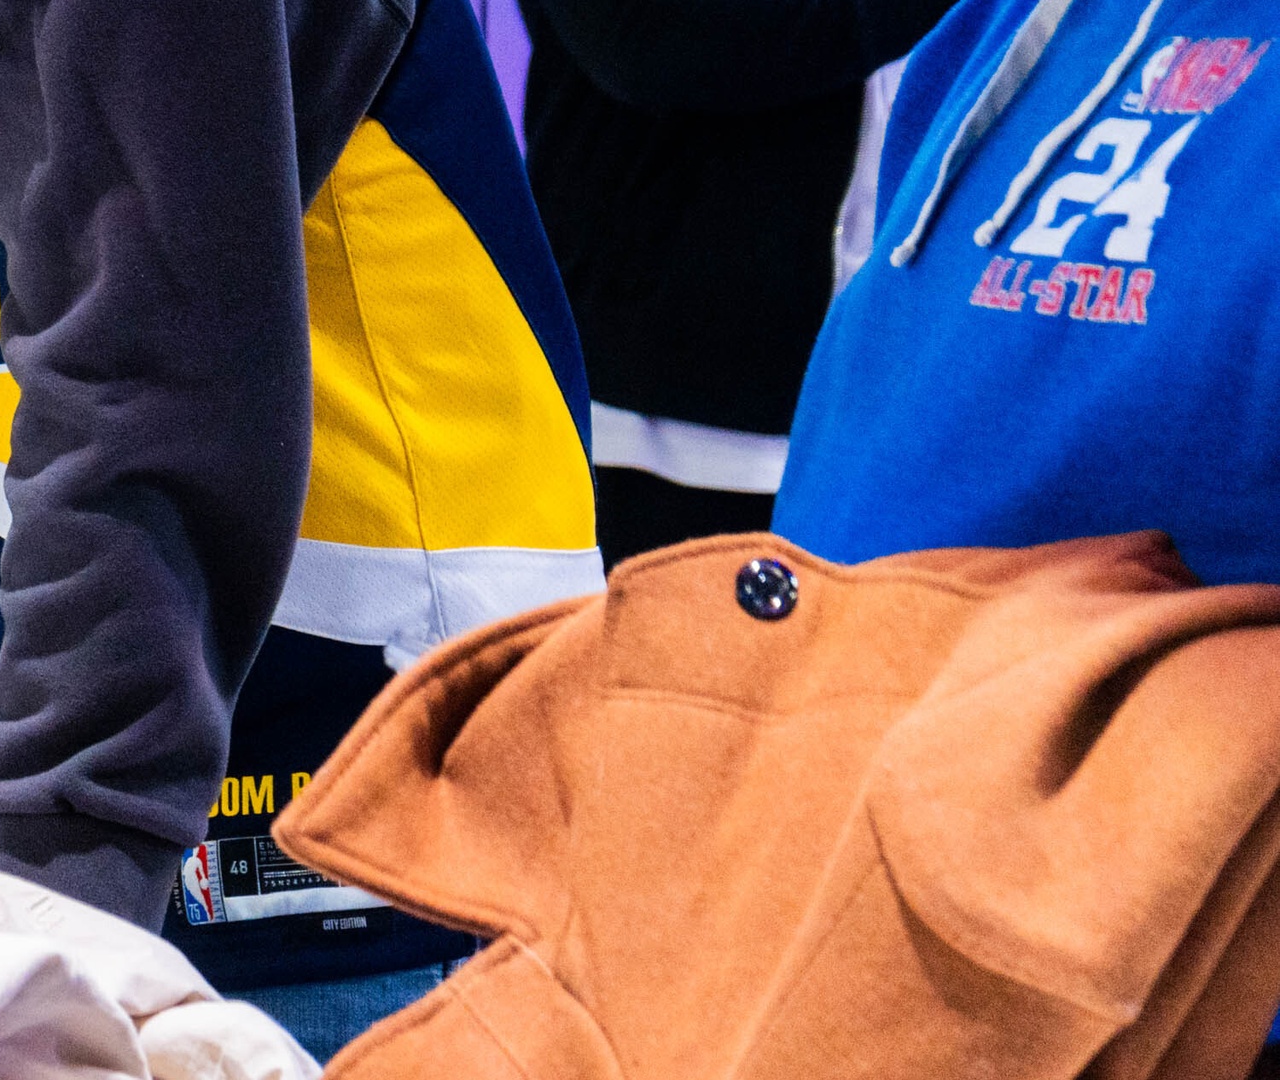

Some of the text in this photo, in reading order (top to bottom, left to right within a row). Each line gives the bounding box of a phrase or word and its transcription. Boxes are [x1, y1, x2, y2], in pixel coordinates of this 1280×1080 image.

[1009, 116, 1202, 263] 24
[969, 254, 1156, 325] ALL-STAR
[208, 773, 274, 818] OM
[230, 860, 248, 875] 48
[188, 903, 201, 921] 75
[322, 916, 367, 930] CITY EDITION
